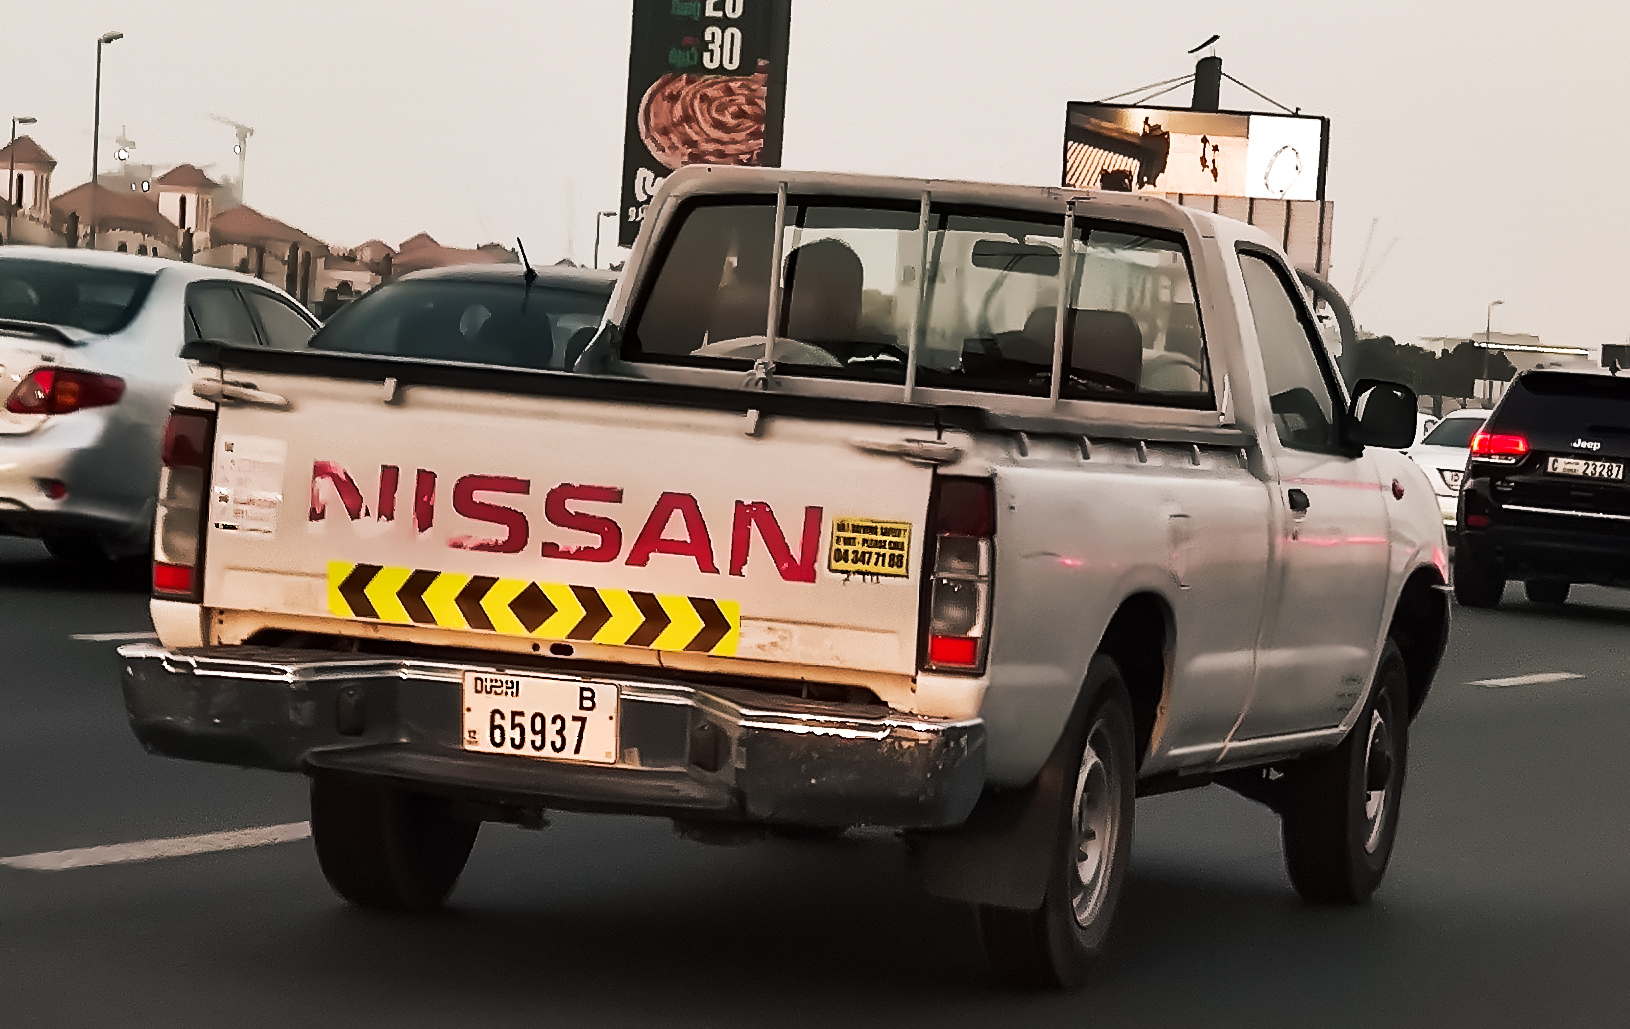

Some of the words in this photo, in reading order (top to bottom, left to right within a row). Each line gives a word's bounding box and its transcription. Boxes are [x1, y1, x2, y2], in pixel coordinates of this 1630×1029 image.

[702, 25, 743, 71] 30
[1572, 438, 1601, 451] Jeep
[1552, 458, 1559, 472] C
[1582, 461, 1622, 479] 23287
[308, 458, 824, 584] NISSAN
[578, 686, 596, 712] B
[488, 708, 588, 755] 65937
